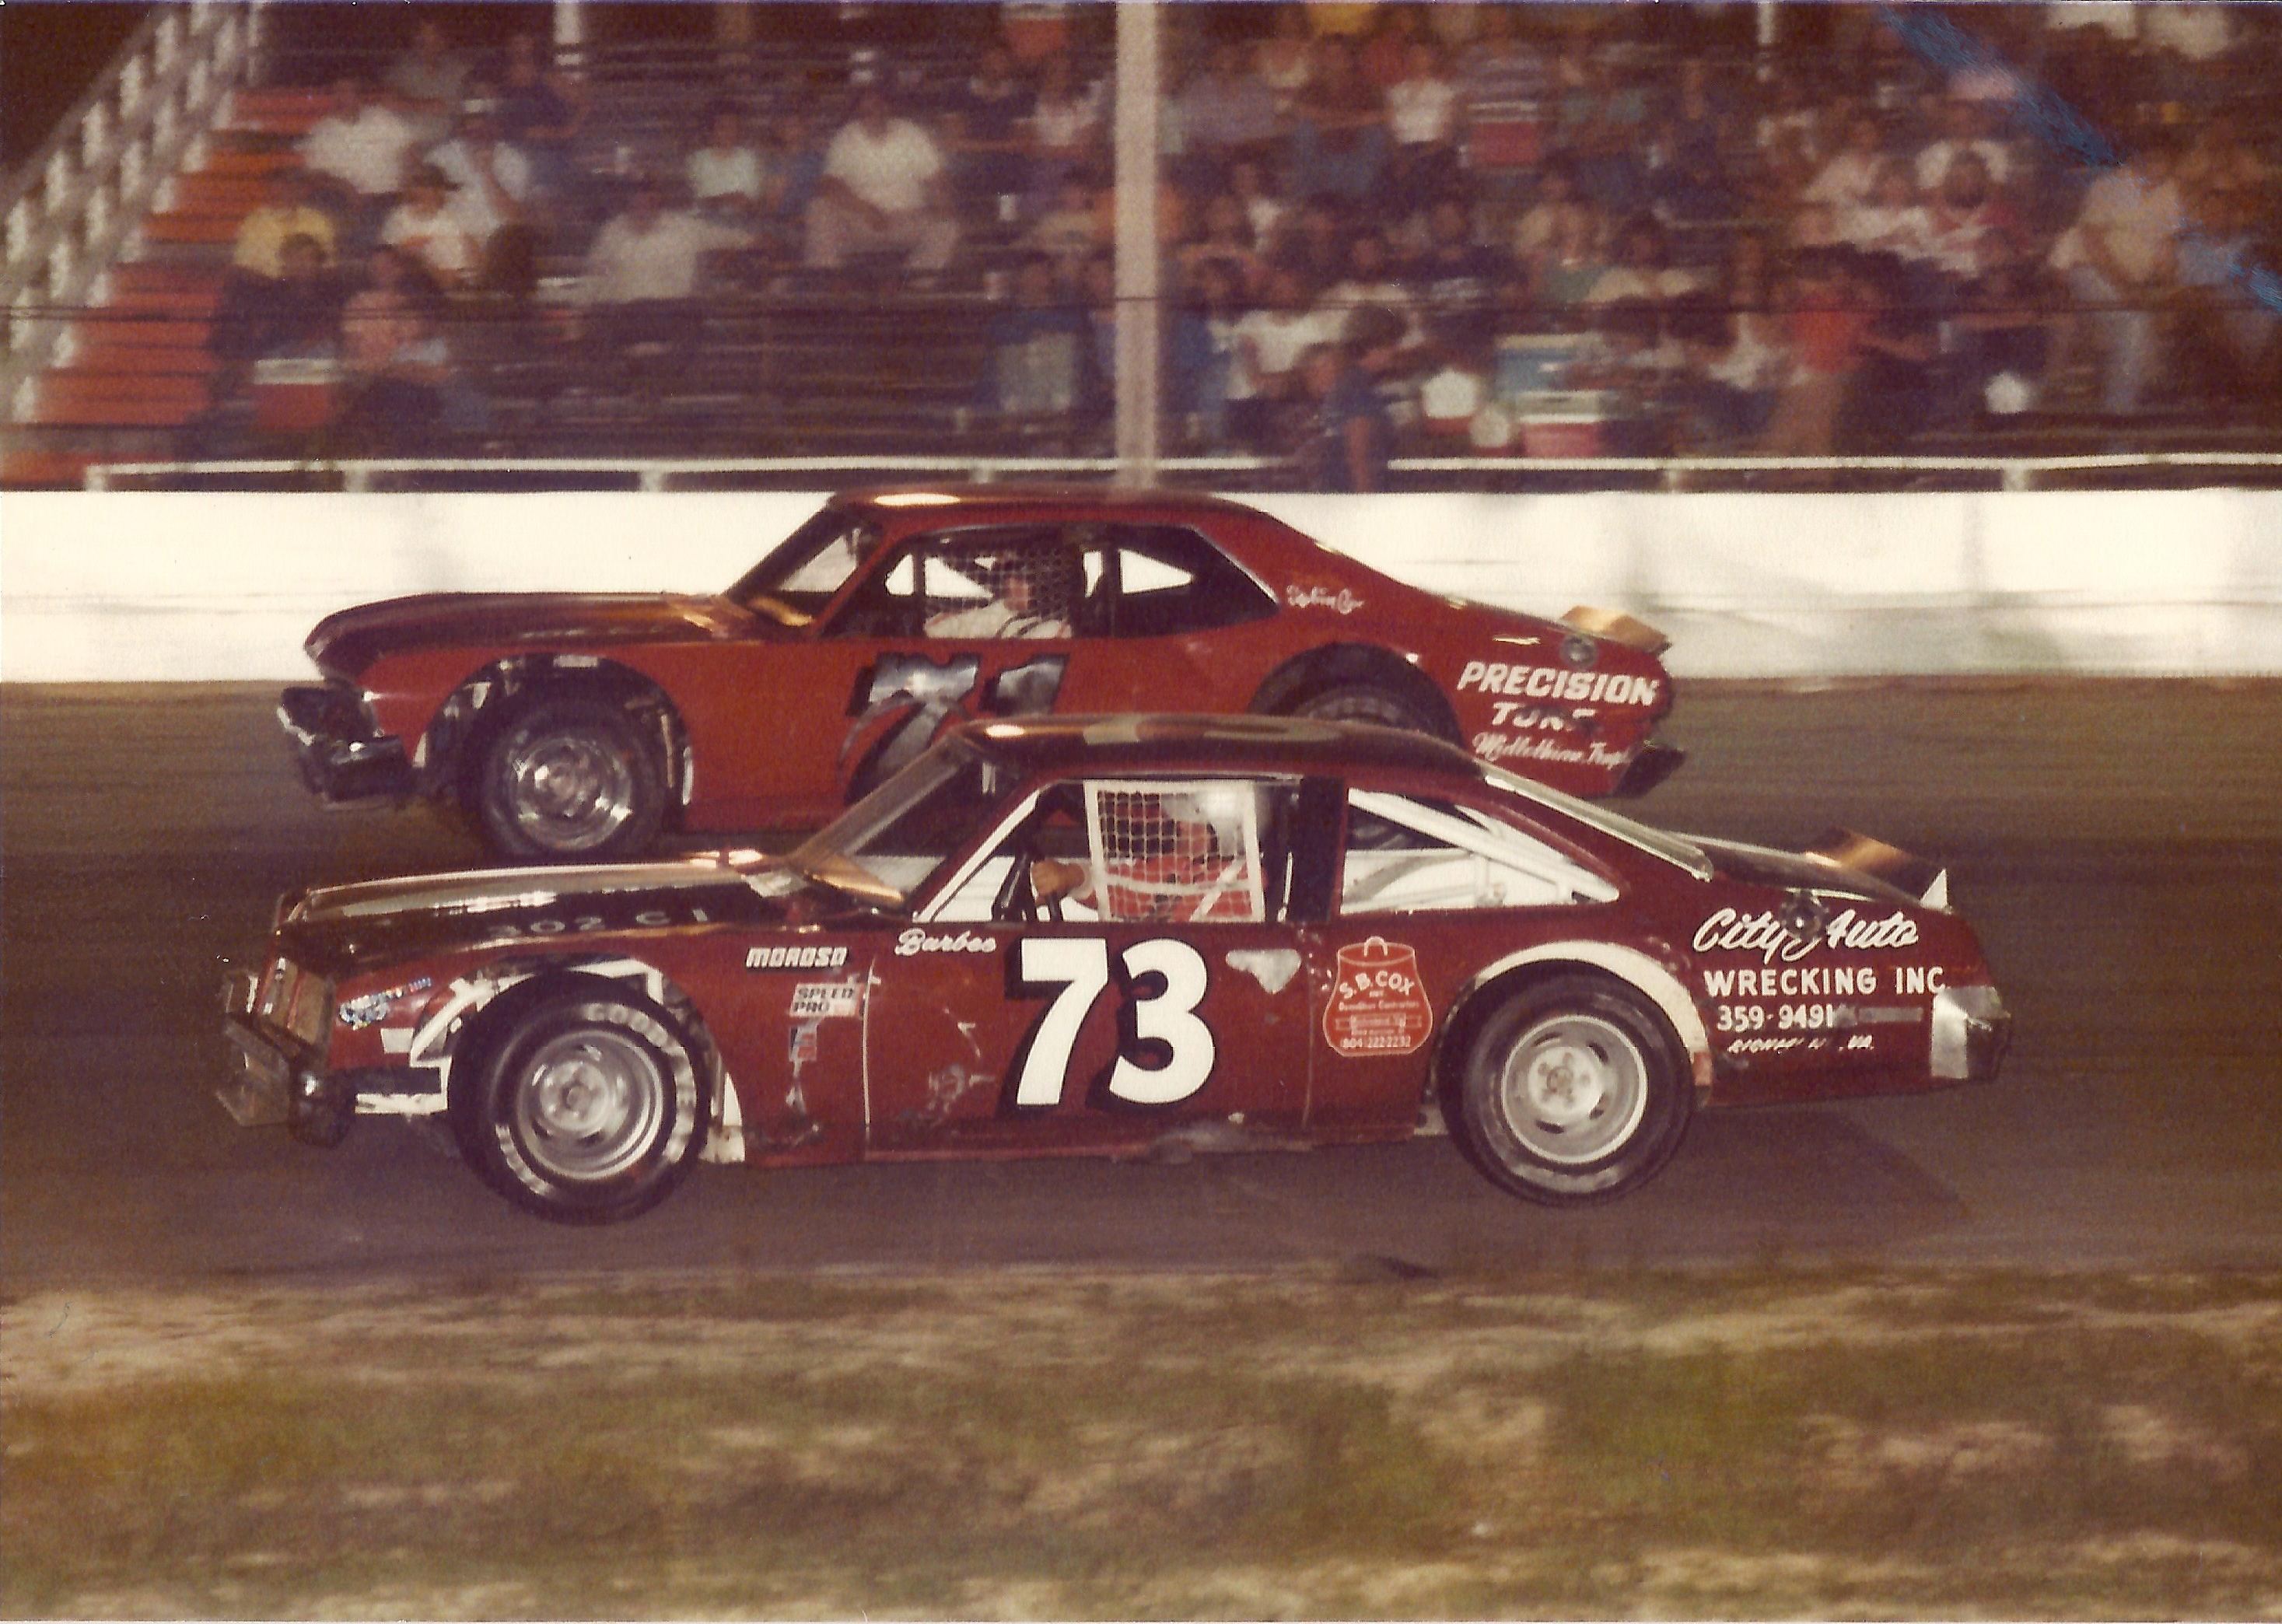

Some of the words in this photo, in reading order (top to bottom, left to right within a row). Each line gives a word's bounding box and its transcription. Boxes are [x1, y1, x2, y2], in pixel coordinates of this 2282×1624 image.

[1457, 660, 1660, 706] PRECISION
[1491, 701, 1598, 731] TUN
[1693, 908, 1792, 965] City
[1825, 908, 1920, 950] Auto
[746, 947, 848, 968] MOROSO
[1703, 968, 1878, 997] WRECKING
[793, 1001, 831, 1013] PRO
[1016, 937, 1216, 1105] 73
